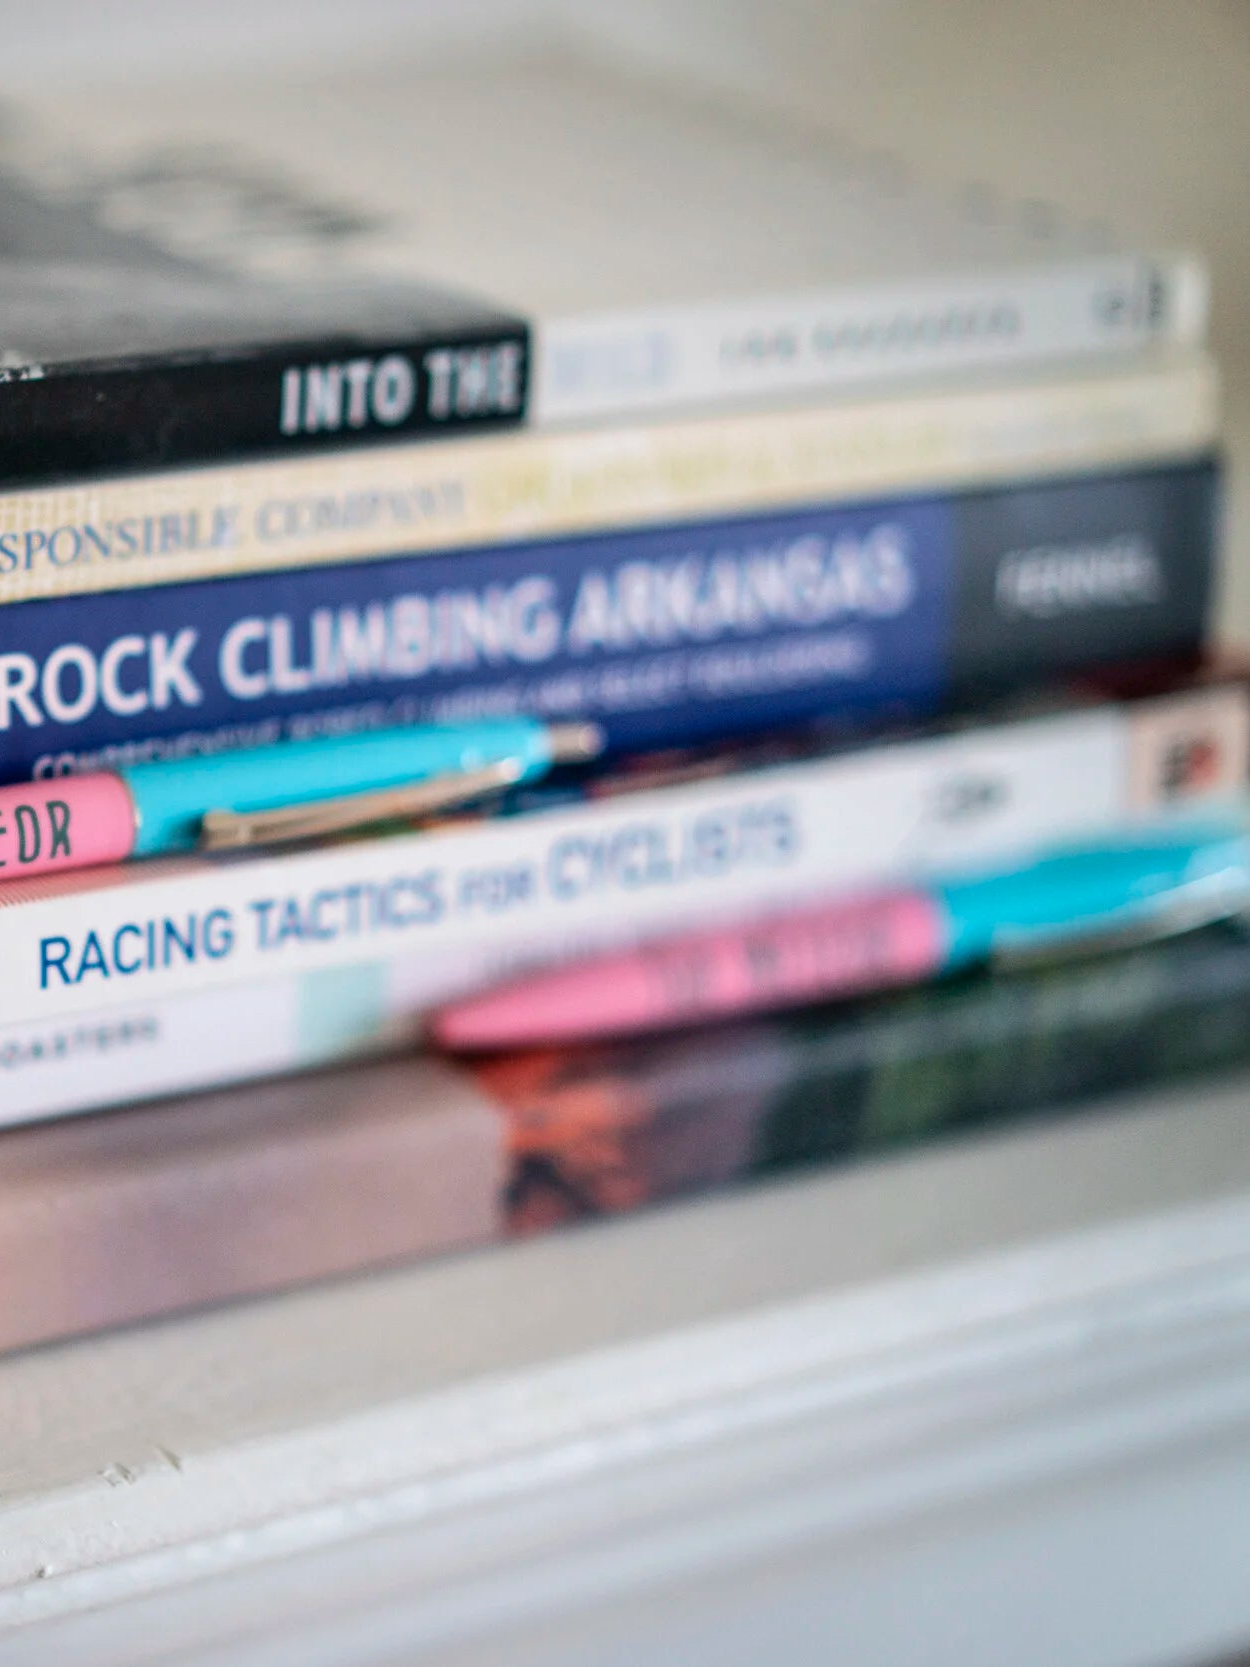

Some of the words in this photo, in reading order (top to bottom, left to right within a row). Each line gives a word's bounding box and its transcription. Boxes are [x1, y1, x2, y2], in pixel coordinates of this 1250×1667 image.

[281, 355, 417, 435] INTO
[424, 341, 522, 420] THE
[255, 476, 467, 544] COMPANY
[217, 575, 559, 700] CLIMBING
[564, 525, 916, 656] ARKANSAS
[37, 907, 236, 990] RACING
[249, 868, 448, 953] TACTICS
[547, 802, 802, 900] CYCLISTS
